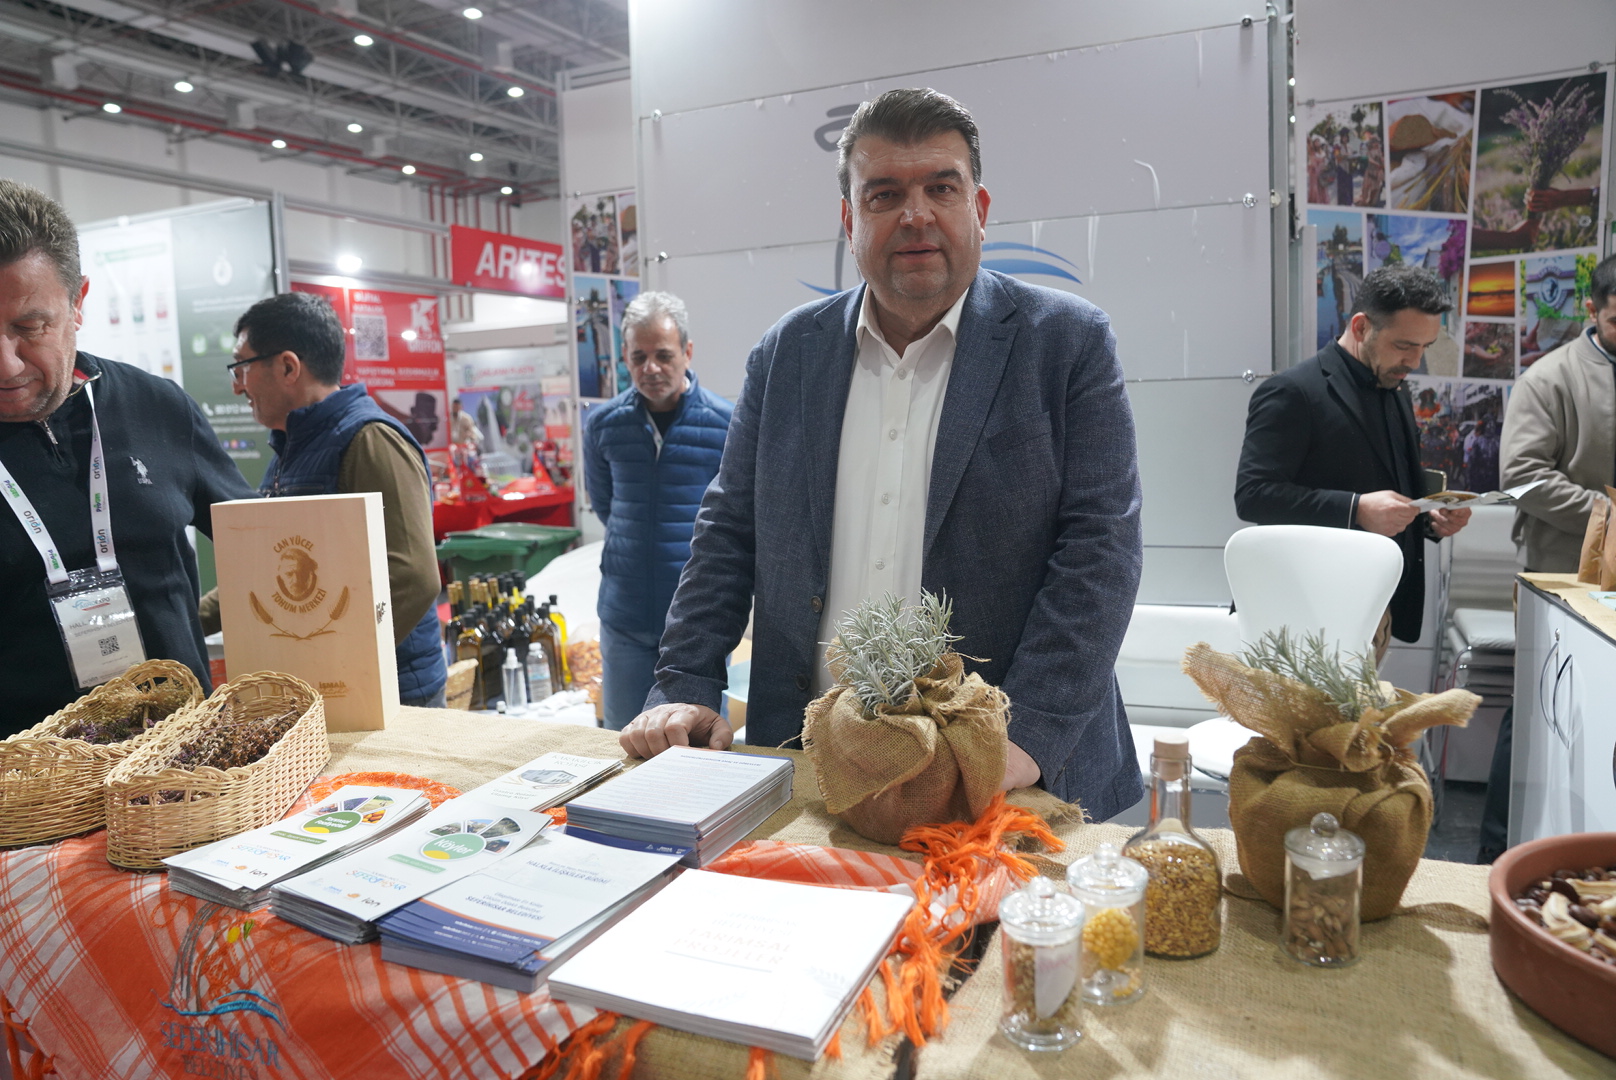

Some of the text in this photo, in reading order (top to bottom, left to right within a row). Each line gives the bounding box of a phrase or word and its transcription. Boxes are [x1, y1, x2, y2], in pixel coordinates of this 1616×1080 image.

[273, 534, 315, 554] CAN YÜCEL
[271, 588, 327, 614] TOHUM MERKEZİ
[434, 838, 474, 855] Köyler
